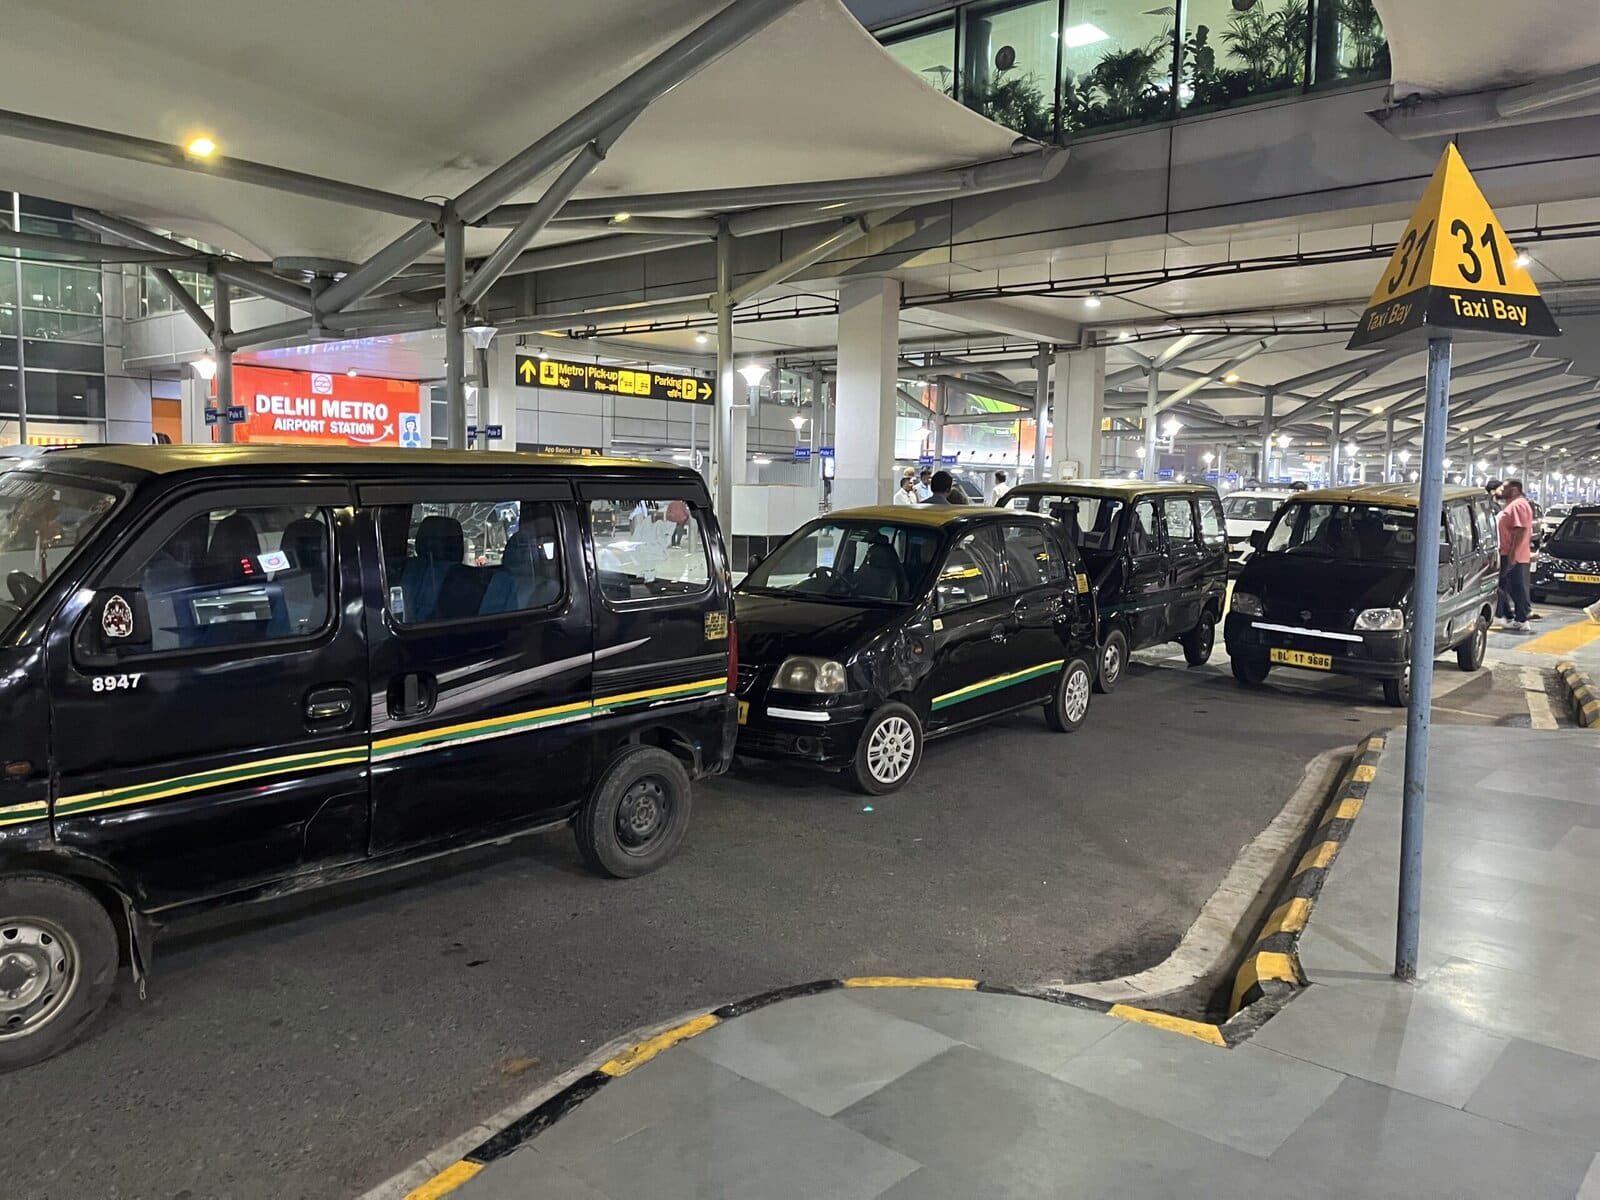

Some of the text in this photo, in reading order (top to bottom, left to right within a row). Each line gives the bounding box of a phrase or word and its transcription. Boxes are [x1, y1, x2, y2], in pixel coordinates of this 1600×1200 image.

[1388, 219, 1436, 295] 31
[1451, 218, 1507, 286] 31
[1366, 302, 1413, 331] Taxi Bay
[1449, 294, 1528, 327] Taxi Bay
[558, 363, 585, 377] Metro
[588, 366, 618, 382] Pick-up
[654, 374, 682, 390] Parking
[254, 393, 389, 421] DELHI METRO
[273, 417, 375, 436] AIRPORT STATION
[1277, 651, 1288, 661] DL
[1294, 653, 1304, 664] 1T
[92, 672, 142, 692] 8947
